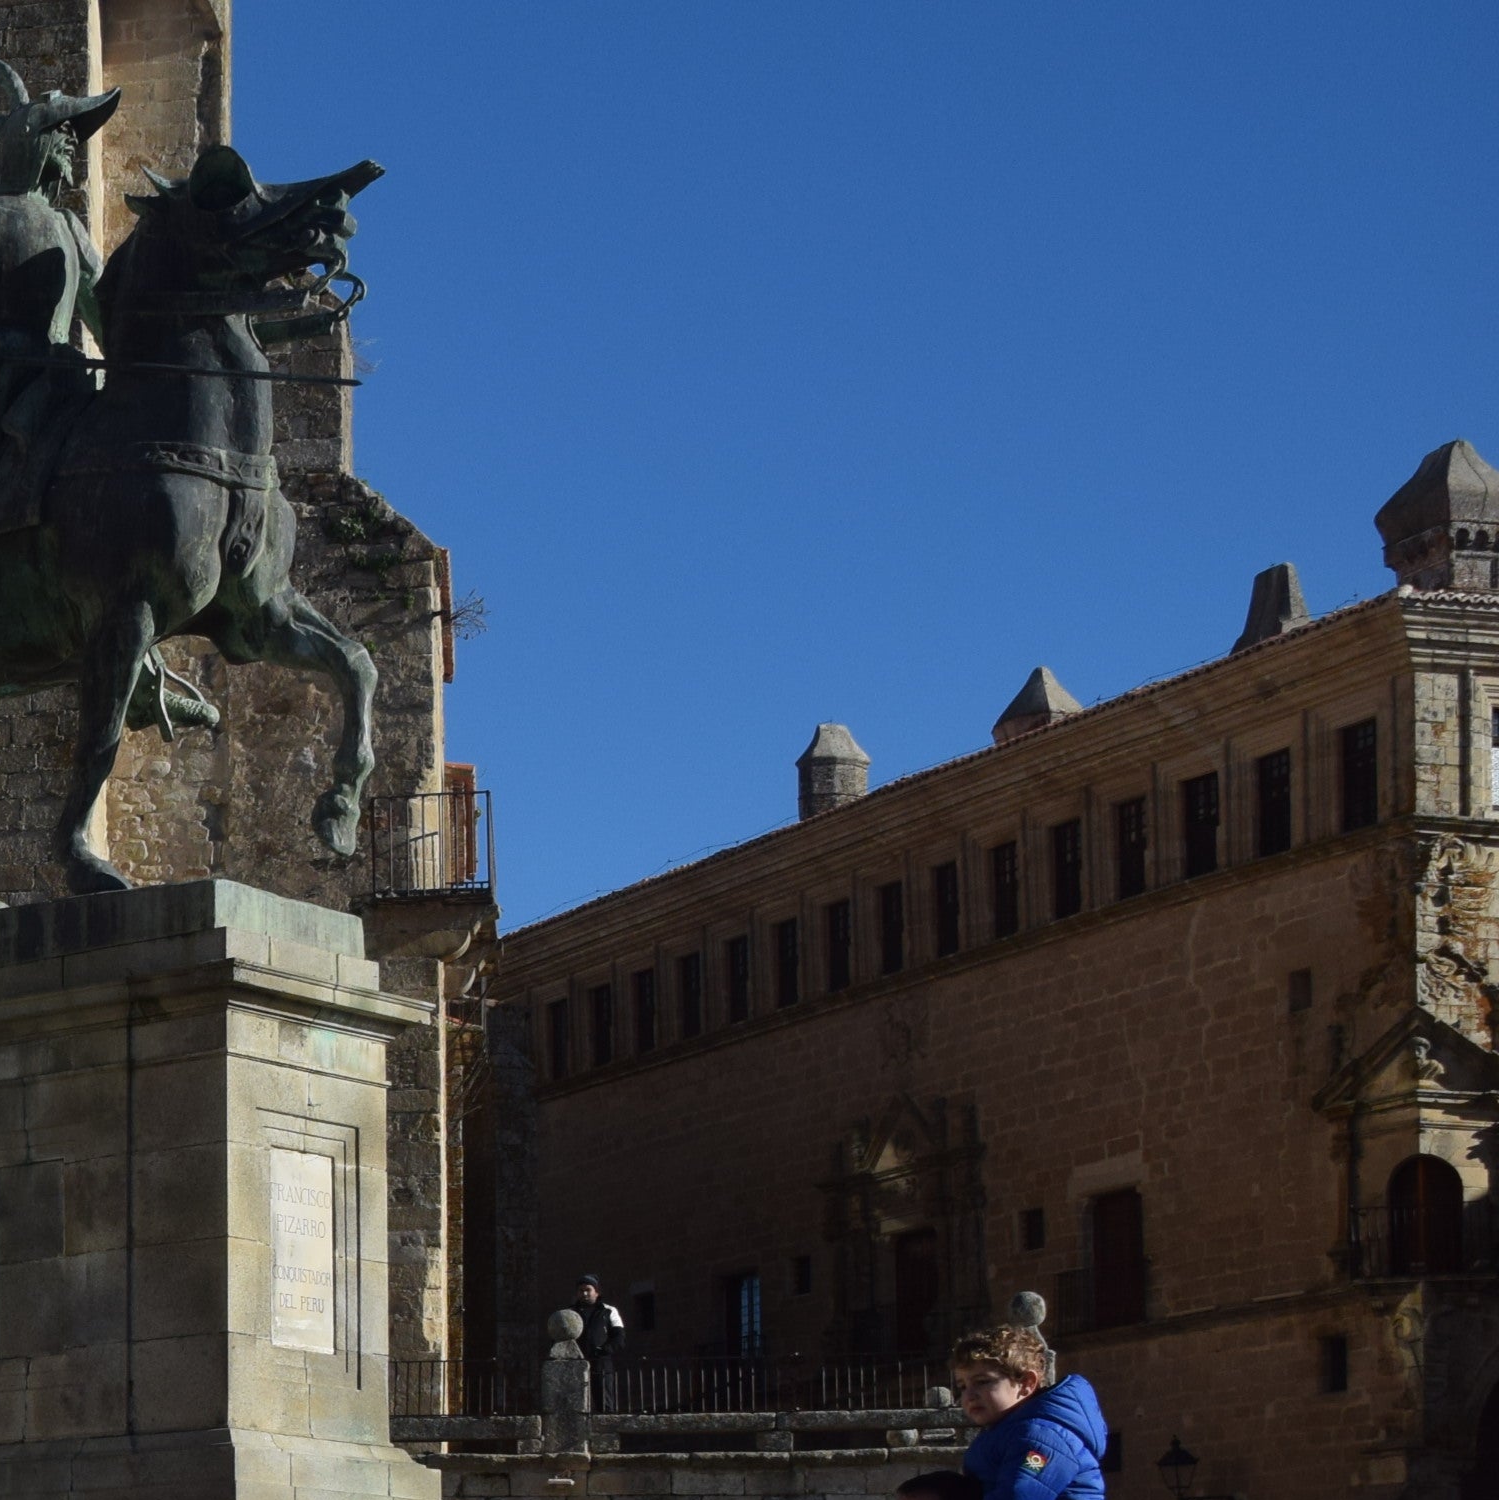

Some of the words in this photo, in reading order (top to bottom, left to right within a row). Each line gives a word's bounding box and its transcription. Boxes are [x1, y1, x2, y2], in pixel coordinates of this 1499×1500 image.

[269, 1181, 331, 1209] FRANCISCO
[276, 1213, 326, 1239] PIZARRO
[272, 1263, 331, 1287] CONQUISTADOR
[279, 1292, 296, 1310] DEL
